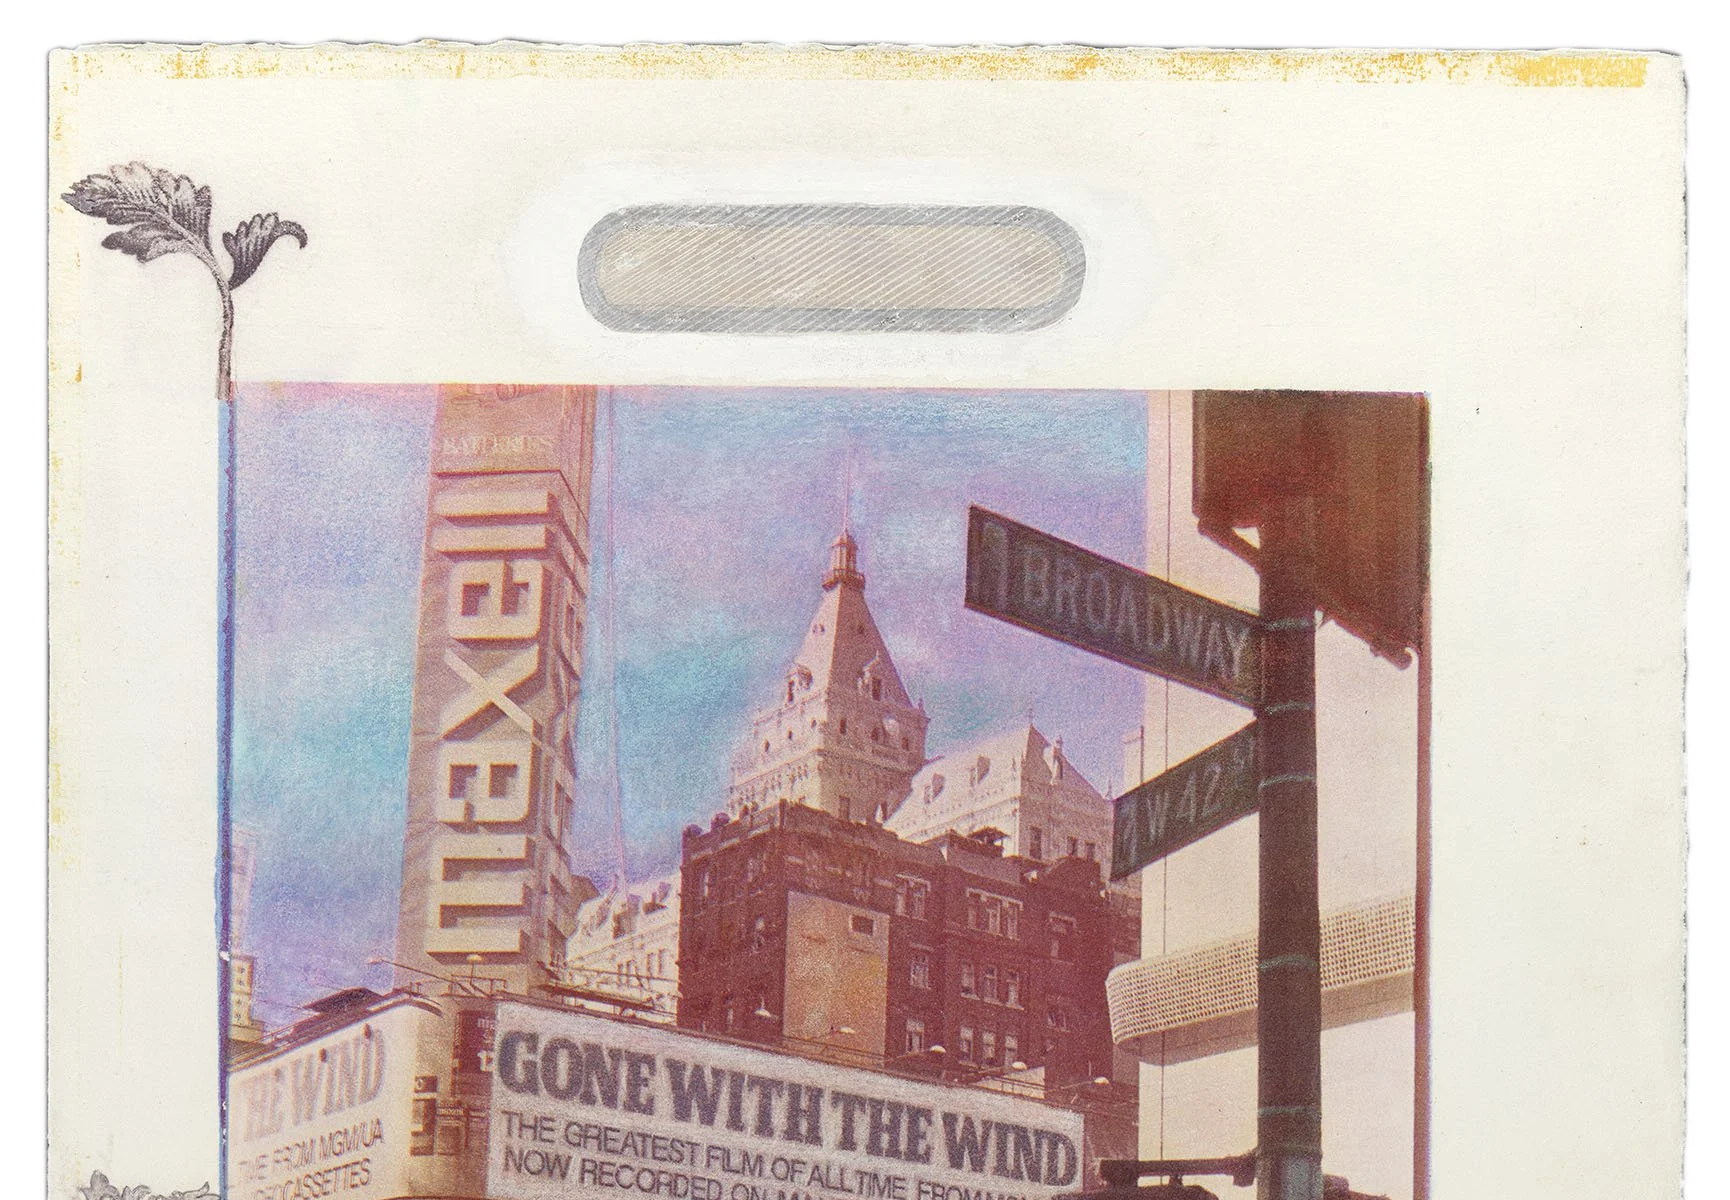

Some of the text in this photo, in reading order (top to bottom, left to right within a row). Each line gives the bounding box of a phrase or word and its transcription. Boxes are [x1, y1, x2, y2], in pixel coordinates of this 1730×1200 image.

[1022, 547, 1248, 682] BROADWAY
[425, 489, 553, 957] maxell
[1177, 761, 1223, 824] 42
[289, 1028, 386, 1127] WIND
[500, 1030, 1078, 1187] GONE WITH THE WIND
[273, 1139, 316, 1174] FROM
[502, 1110, 556, 1143] THE
[563, 1121, 699, 1167] GREATEST
[705, 1145, 763, 1179] FILM
[771, 1157, 806, 1182] OF
[806, 1164, 853, 1193] ALL
[852, 1169, 906, 1200] TIME
[503, 1146, 572, 1180] NOW
